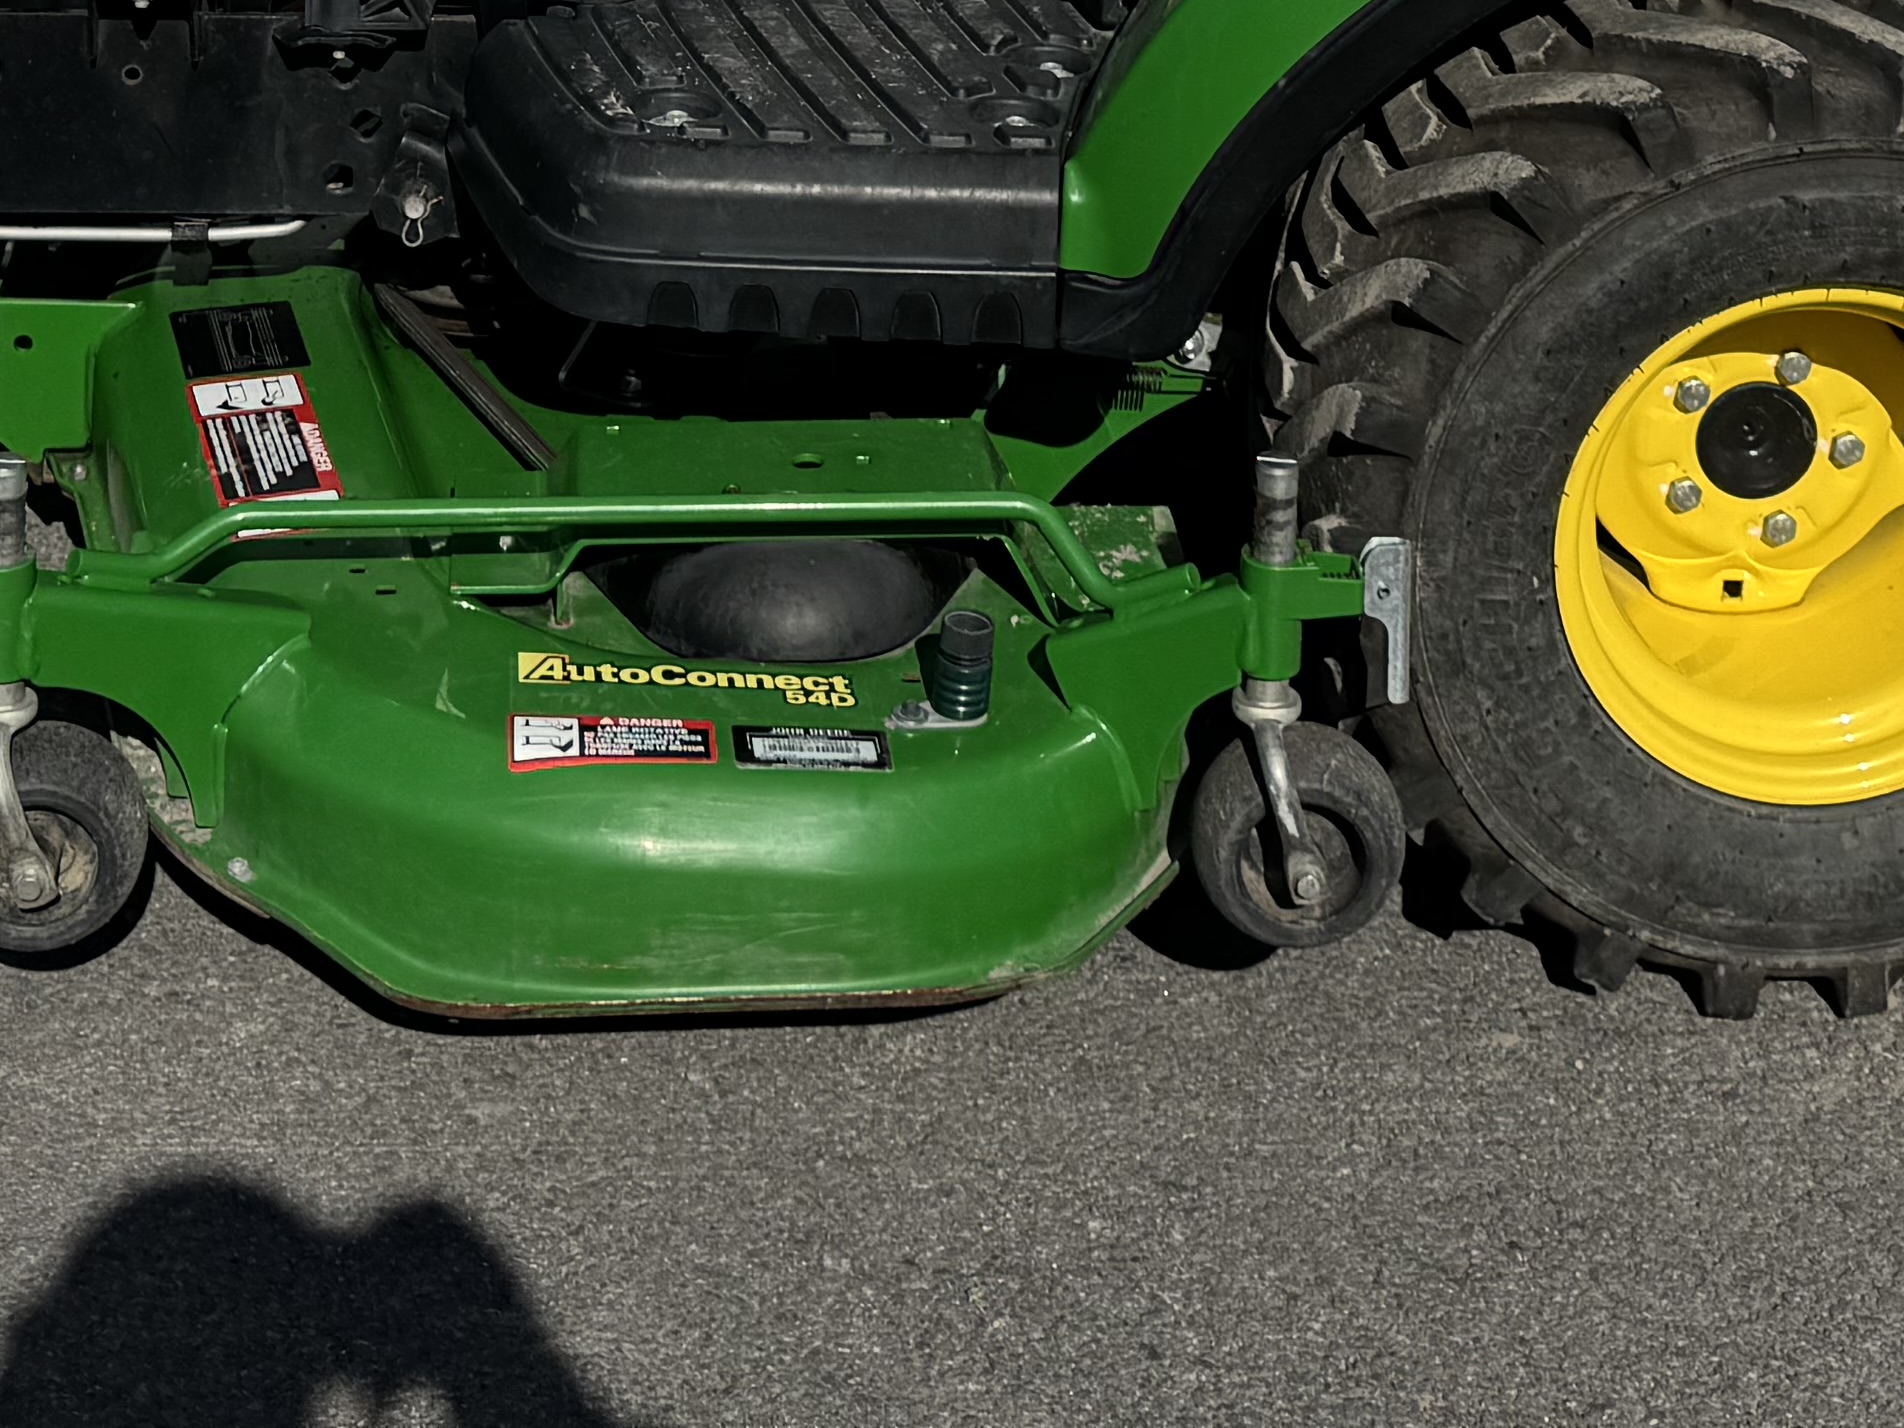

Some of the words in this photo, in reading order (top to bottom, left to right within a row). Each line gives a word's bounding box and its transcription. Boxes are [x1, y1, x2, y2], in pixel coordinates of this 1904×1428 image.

[307, 429, 334, 472] DANGER
[523, 655, 852, 694] AutoConnect
[786, 690, 858, 709] 54D
[618, 717, 683, 727] DANGER
